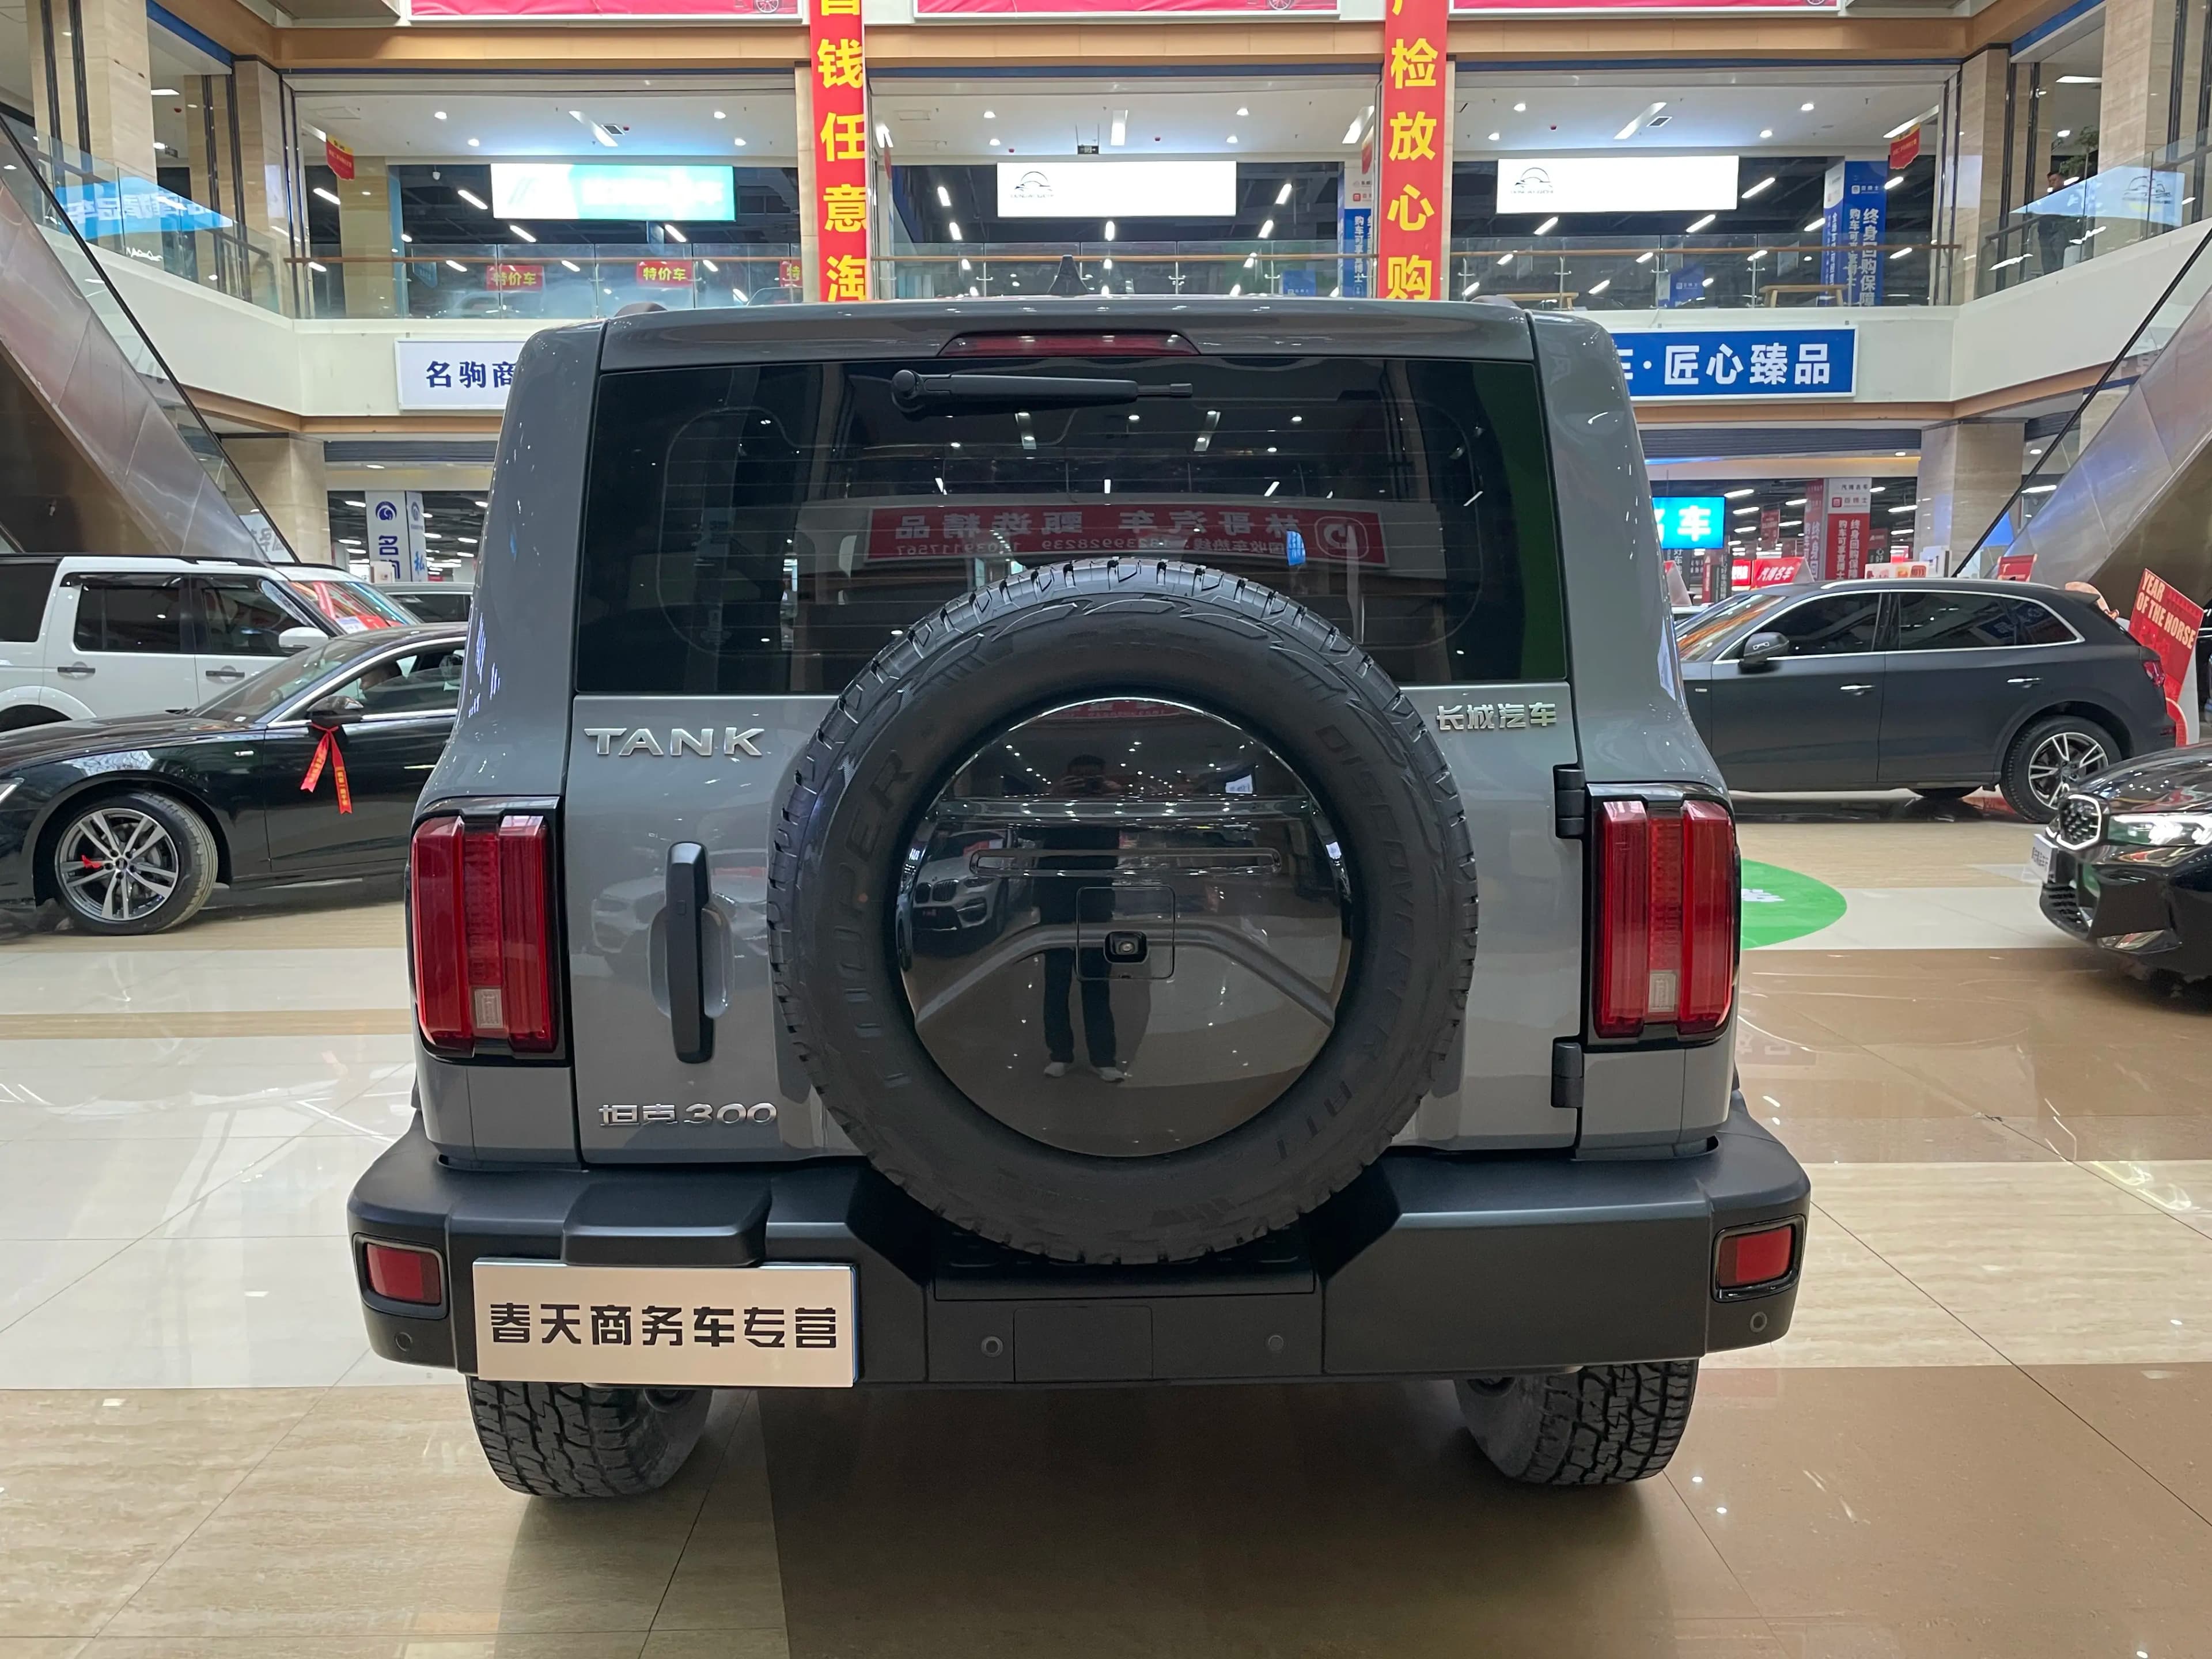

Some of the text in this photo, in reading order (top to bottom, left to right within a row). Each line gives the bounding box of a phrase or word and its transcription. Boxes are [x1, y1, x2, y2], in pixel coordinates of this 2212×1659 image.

[493, 271, 537, 286] 特价车
[642, 267, 687, 281] 特价车
[2142, 571, 2166, 603] YEAR
[2136, 591, 2150, 615] OF
[2147, 599, 2166, 627] THE
[2164, 611, 2196, 650] HORSE
[1437, 702, 1557, 730] 长城汽车
[584, 727, 765, 756] TANK
[490, 1302, 837, 1349] 春天商务车专营
